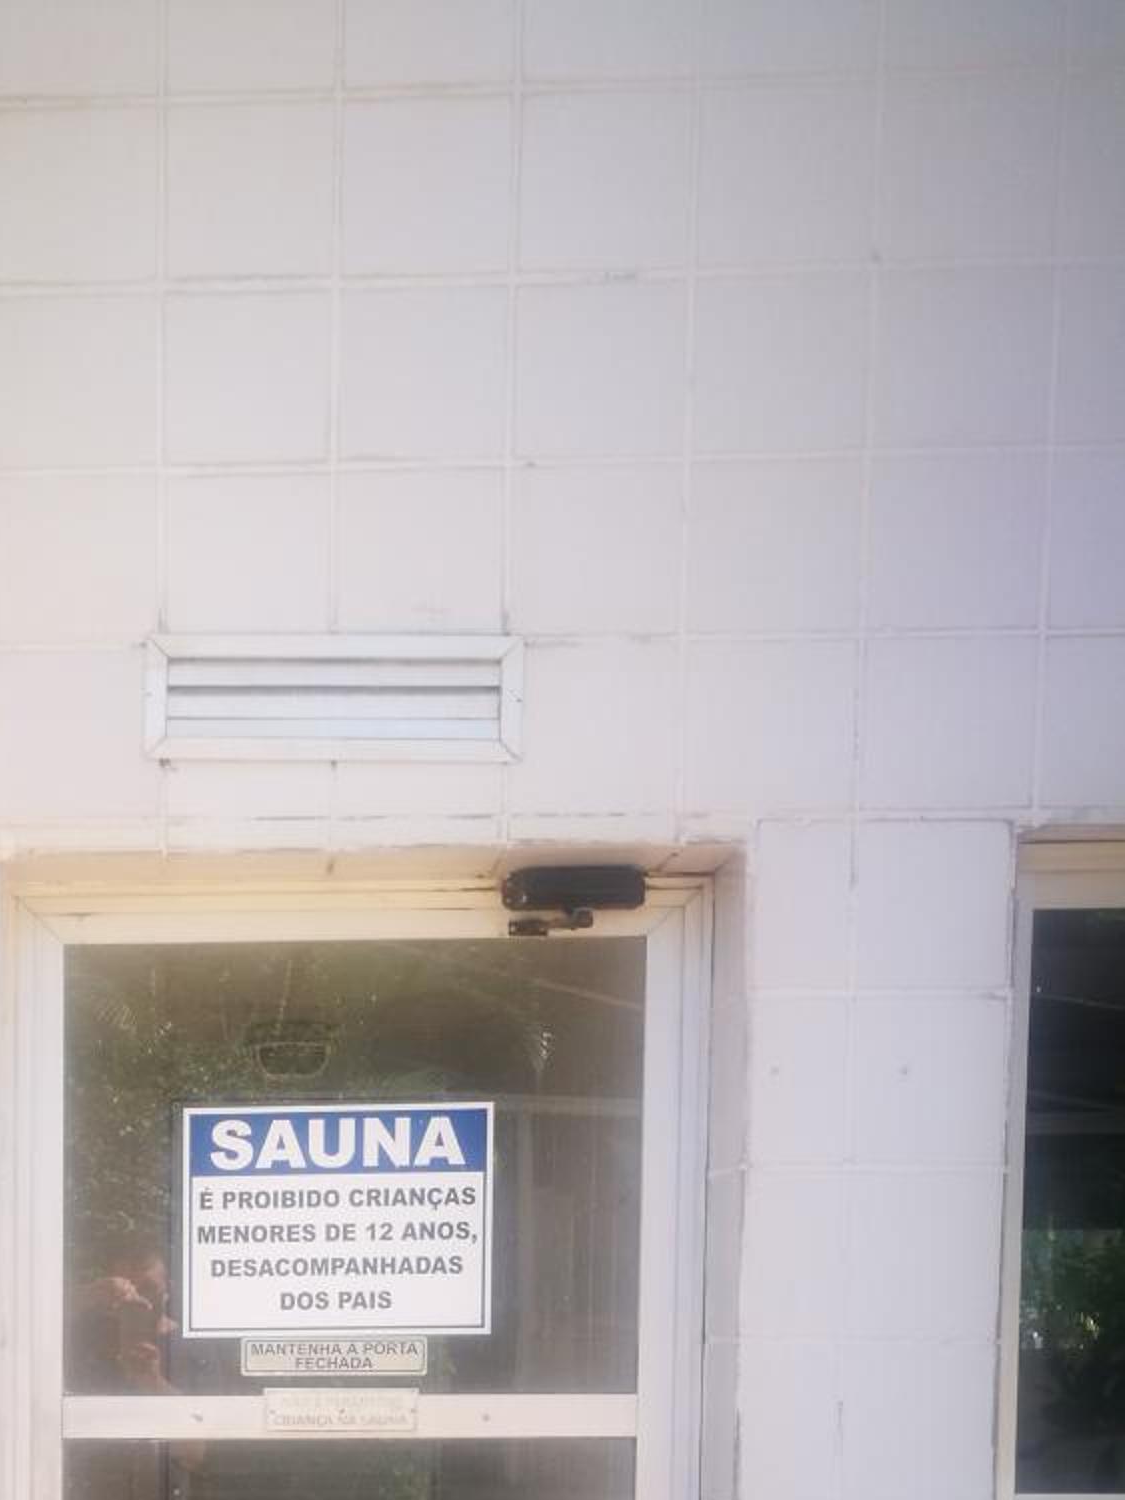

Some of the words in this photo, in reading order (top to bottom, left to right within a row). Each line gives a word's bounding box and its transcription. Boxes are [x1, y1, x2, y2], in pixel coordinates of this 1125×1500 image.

[210, 1116, 466, 1170] SAUNA
[199, 1187, 214, 1210] É
[222, 1189, 340, 1210] PROIBIDO
[349, 1187, 477, 1211] CRIANÇAS
[197, 1223, 316, 1244] MENORES
[325, 1223, 356, 1242] DE
[365, 1222, 393, 1242] 12
[402, 1221, 478, 1245] ANOS,
[211, 1255, 463, 1278] DESACOMPANHADAS
[280, 1291, 329, 1311] DOS
[338, 1291, 393, 1310] PAIS
[250, 1343, 341, 1355] MANTENHA
[346, 1343, 359, 1355] A
[362, 1343, 419, 1355] PORTA
[295, 1357, 373, 1369] FECHADA
